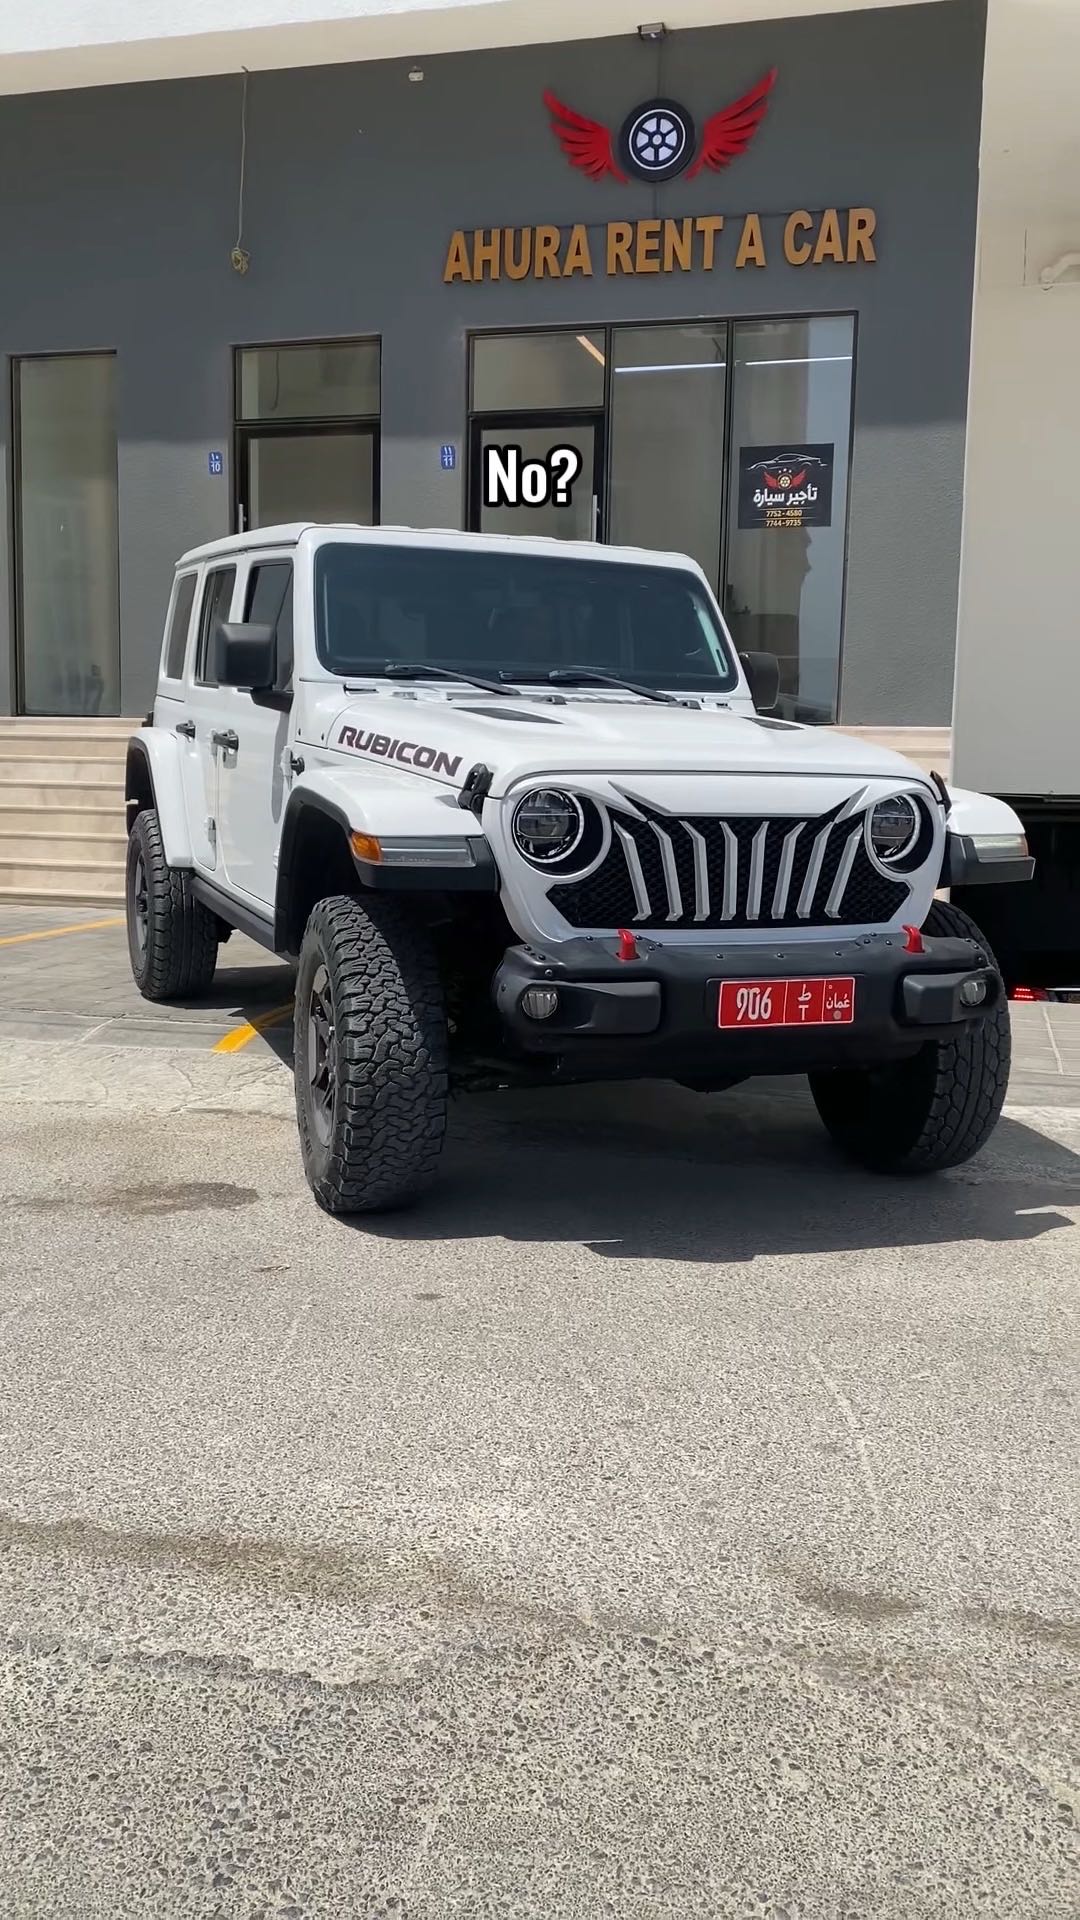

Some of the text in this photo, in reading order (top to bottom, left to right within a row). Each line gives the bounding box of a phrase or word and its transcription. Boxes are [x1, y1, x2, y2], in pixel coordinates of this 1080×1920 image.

[443, 207, 878, 283] AHURA RENT A CAR
[210, 462, 220, 472] 10
[443, 456, 453, 467] 11
[753, 483, 818, 507] تأجير سيارة
[338, 725, 463, 777] RUBICON
[799, 1004, 809, 1021] T
